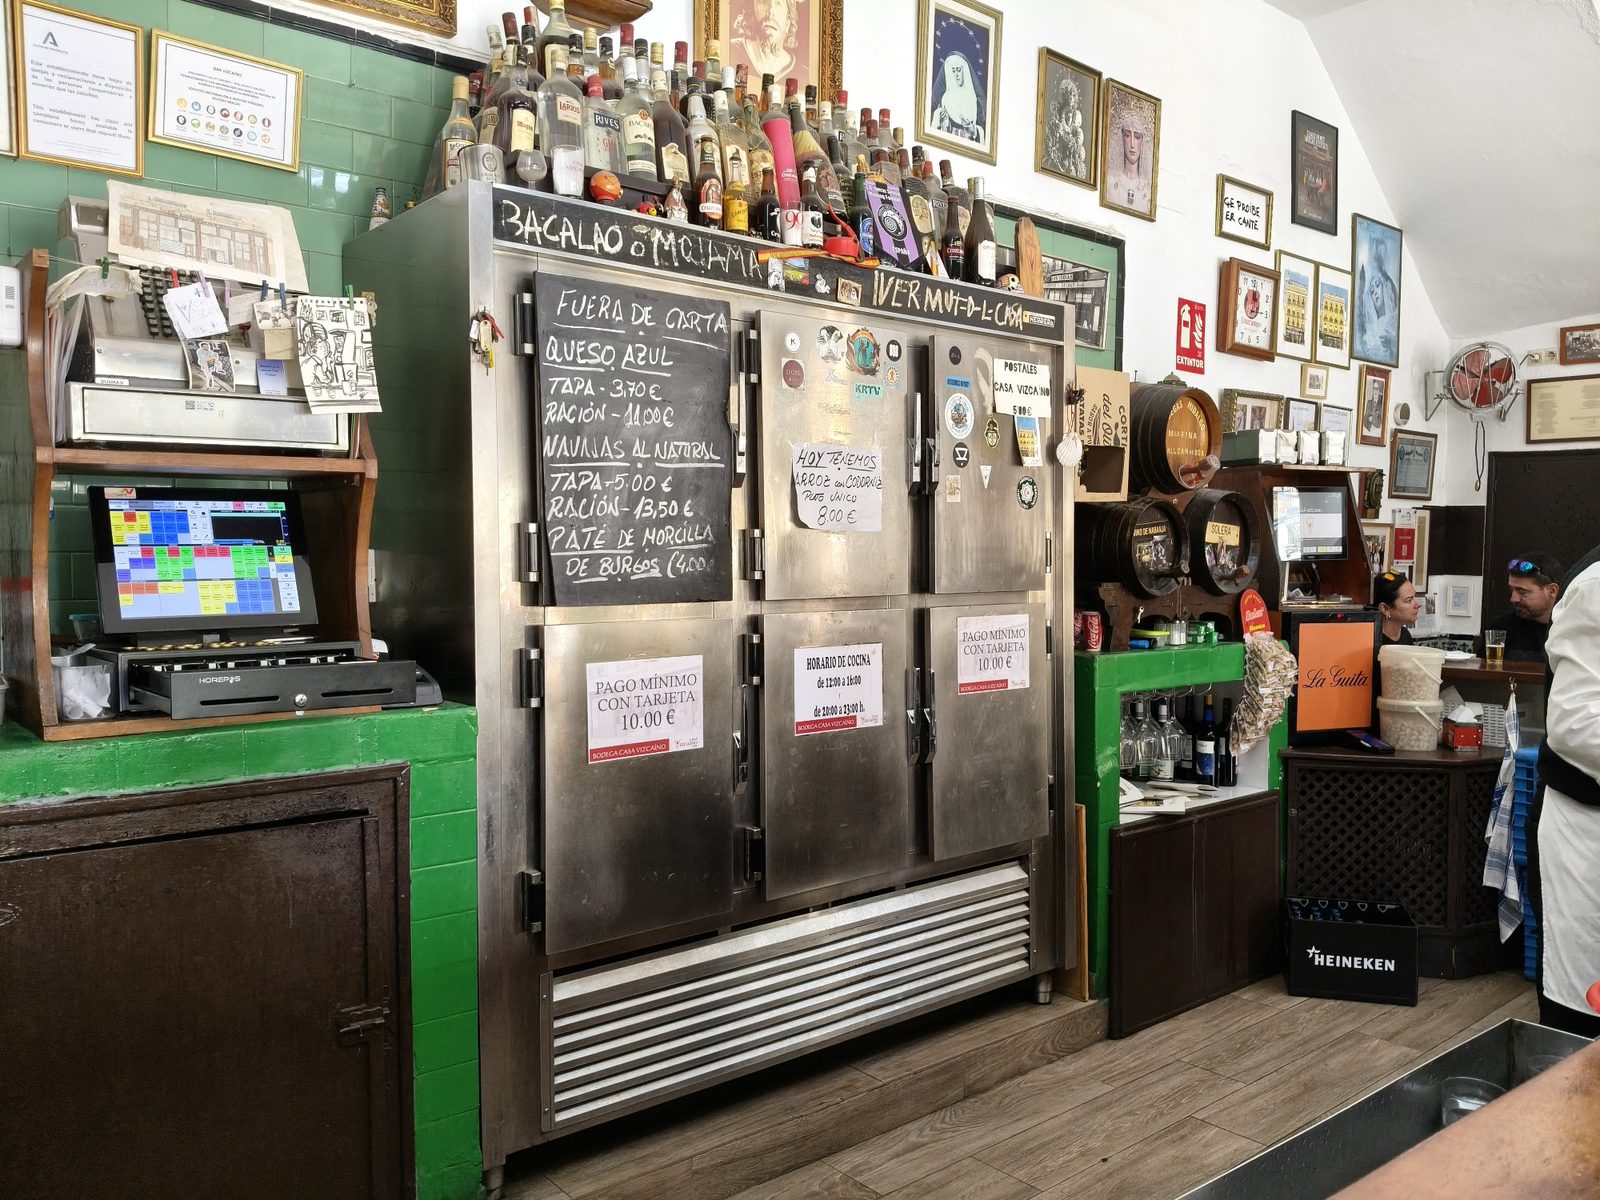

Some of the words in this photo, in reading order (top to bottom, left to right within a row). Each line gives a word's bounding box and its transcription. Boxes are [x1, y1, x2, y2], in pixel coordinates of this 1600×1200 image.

[595, 114, 620, 129] RIVES
[502, 199, 623, 255] BACALAO
[1225, 211, 1236, 223] ER
[1238, 216, 1260, 231] CANTE
[557, 290, 624, 322] FUERA
[631, 302, 656, 326] DE
[665, 308, 728, 334] CARTA
[545, 336, 616, 366] QUESO
[622, 343, 674, 367] AZUL
[1004, 361, 1038, 375] POSTALES
[1177, 355, 1204, 369] EXTINTOR
[548, 377, 596, 396] TAPA
[994, 382, 1014, 393] CASA
[545, 402, 606, 425] RACIÓN
[1103, 393, 1112, 419] del
[1187, 401, 1206, 431] HIDALGO
[1181, 430, 1198, 440] FINA
[543, 434, 625, 458] NAVAJAS
[632, 437, 650, 458] AL
[655, 441, 720, 460] NATURAL
[797, 451, 825, 467] HOY
[827, 451, 877, 469] TENEMOS
[618, 528, 634, 548] DE
[1212, 524, 1231, 535] SOLERA
[566, 558, 588, 576] DE
[962, 631, 988, 642] PAGO
[990, 627, 1026, 640] MÍNIMO
[1087, 616, 1099, 649] Coca-Cola
[964, 644, 984, 655] CON
[986, 642, 1025, 654] TARJETA
[806, 656, 836, 670] HORARIO
[838, 656, 846, 668] DE
[848, 654, 871, 666] COCINA
[979, 656, 1003, 671] 10.00
[1006, 656, 1012, 668] €
[596, 679, 636, 695] PAGO
[640, 673, 697, 691] MÍNIMO
[817, 677, 825, 688] de
[825, 677, 841, 688] 12:00
[846, 675, 861, 686] 16:00
[1303, 667, 1326, 689] La
[1329, 666, 1368, 688] Guita
[598, 697, 630, 712] CON
[634, 691, 696, 707] TARJETA
[814, 705, 821, 717] de
[822, 705, 837, 716] 20:00
[844, 703, 858, 715] 23:00
[860, 701, 865, 712] h.
[622, 711, 662, 730] 10.00
[667, 709, 675, 725] €
[592, 750, 618, 760] BODEGA
[619, 747, 636, 756] CASA
[636, 743, 667, 754] VIZCAÍNO
[1314, 953, 1396, 972] HEINEKEN
